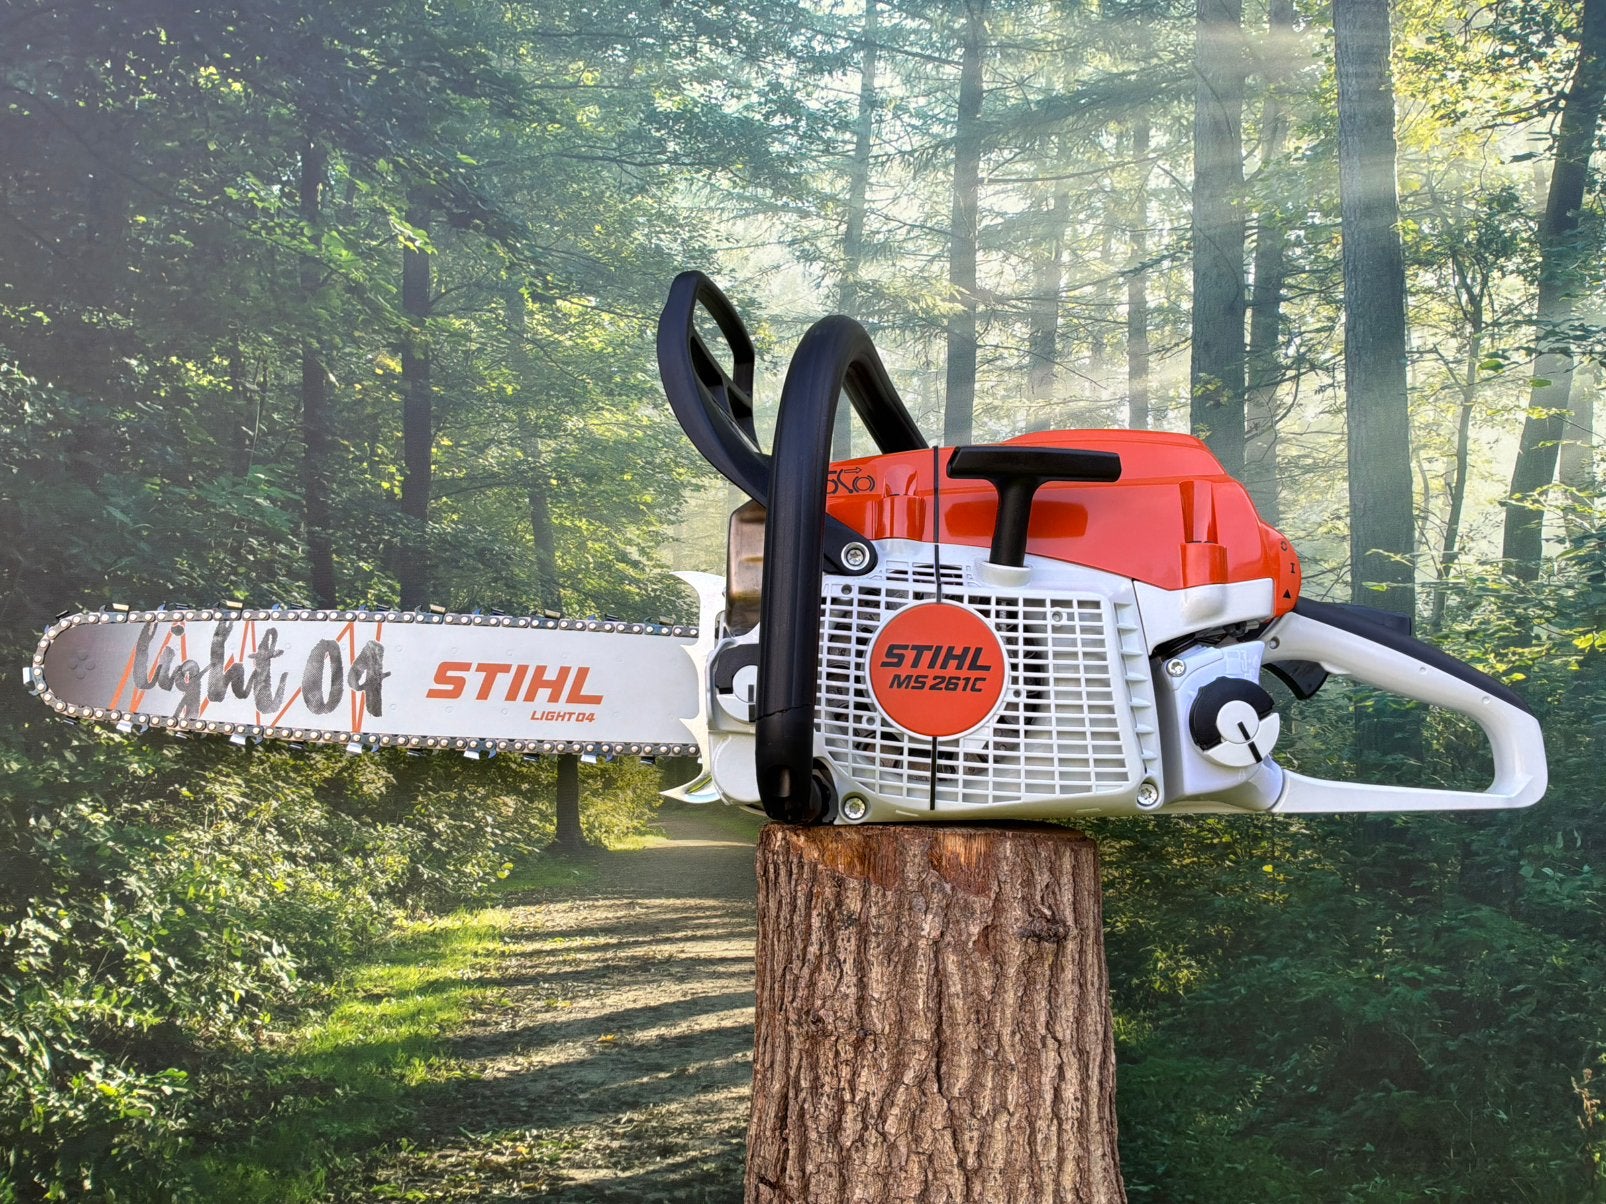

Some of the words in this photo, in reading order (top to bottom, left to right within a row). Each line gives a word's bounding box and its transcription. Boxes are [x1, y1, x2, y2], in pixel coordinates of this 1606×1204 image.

[880, 643, 992, 672] STIHL
[426, 661, 604, 705] STIHL
[888, 673, 929, 691] MS
[928, 675, 987, 693] 261C
